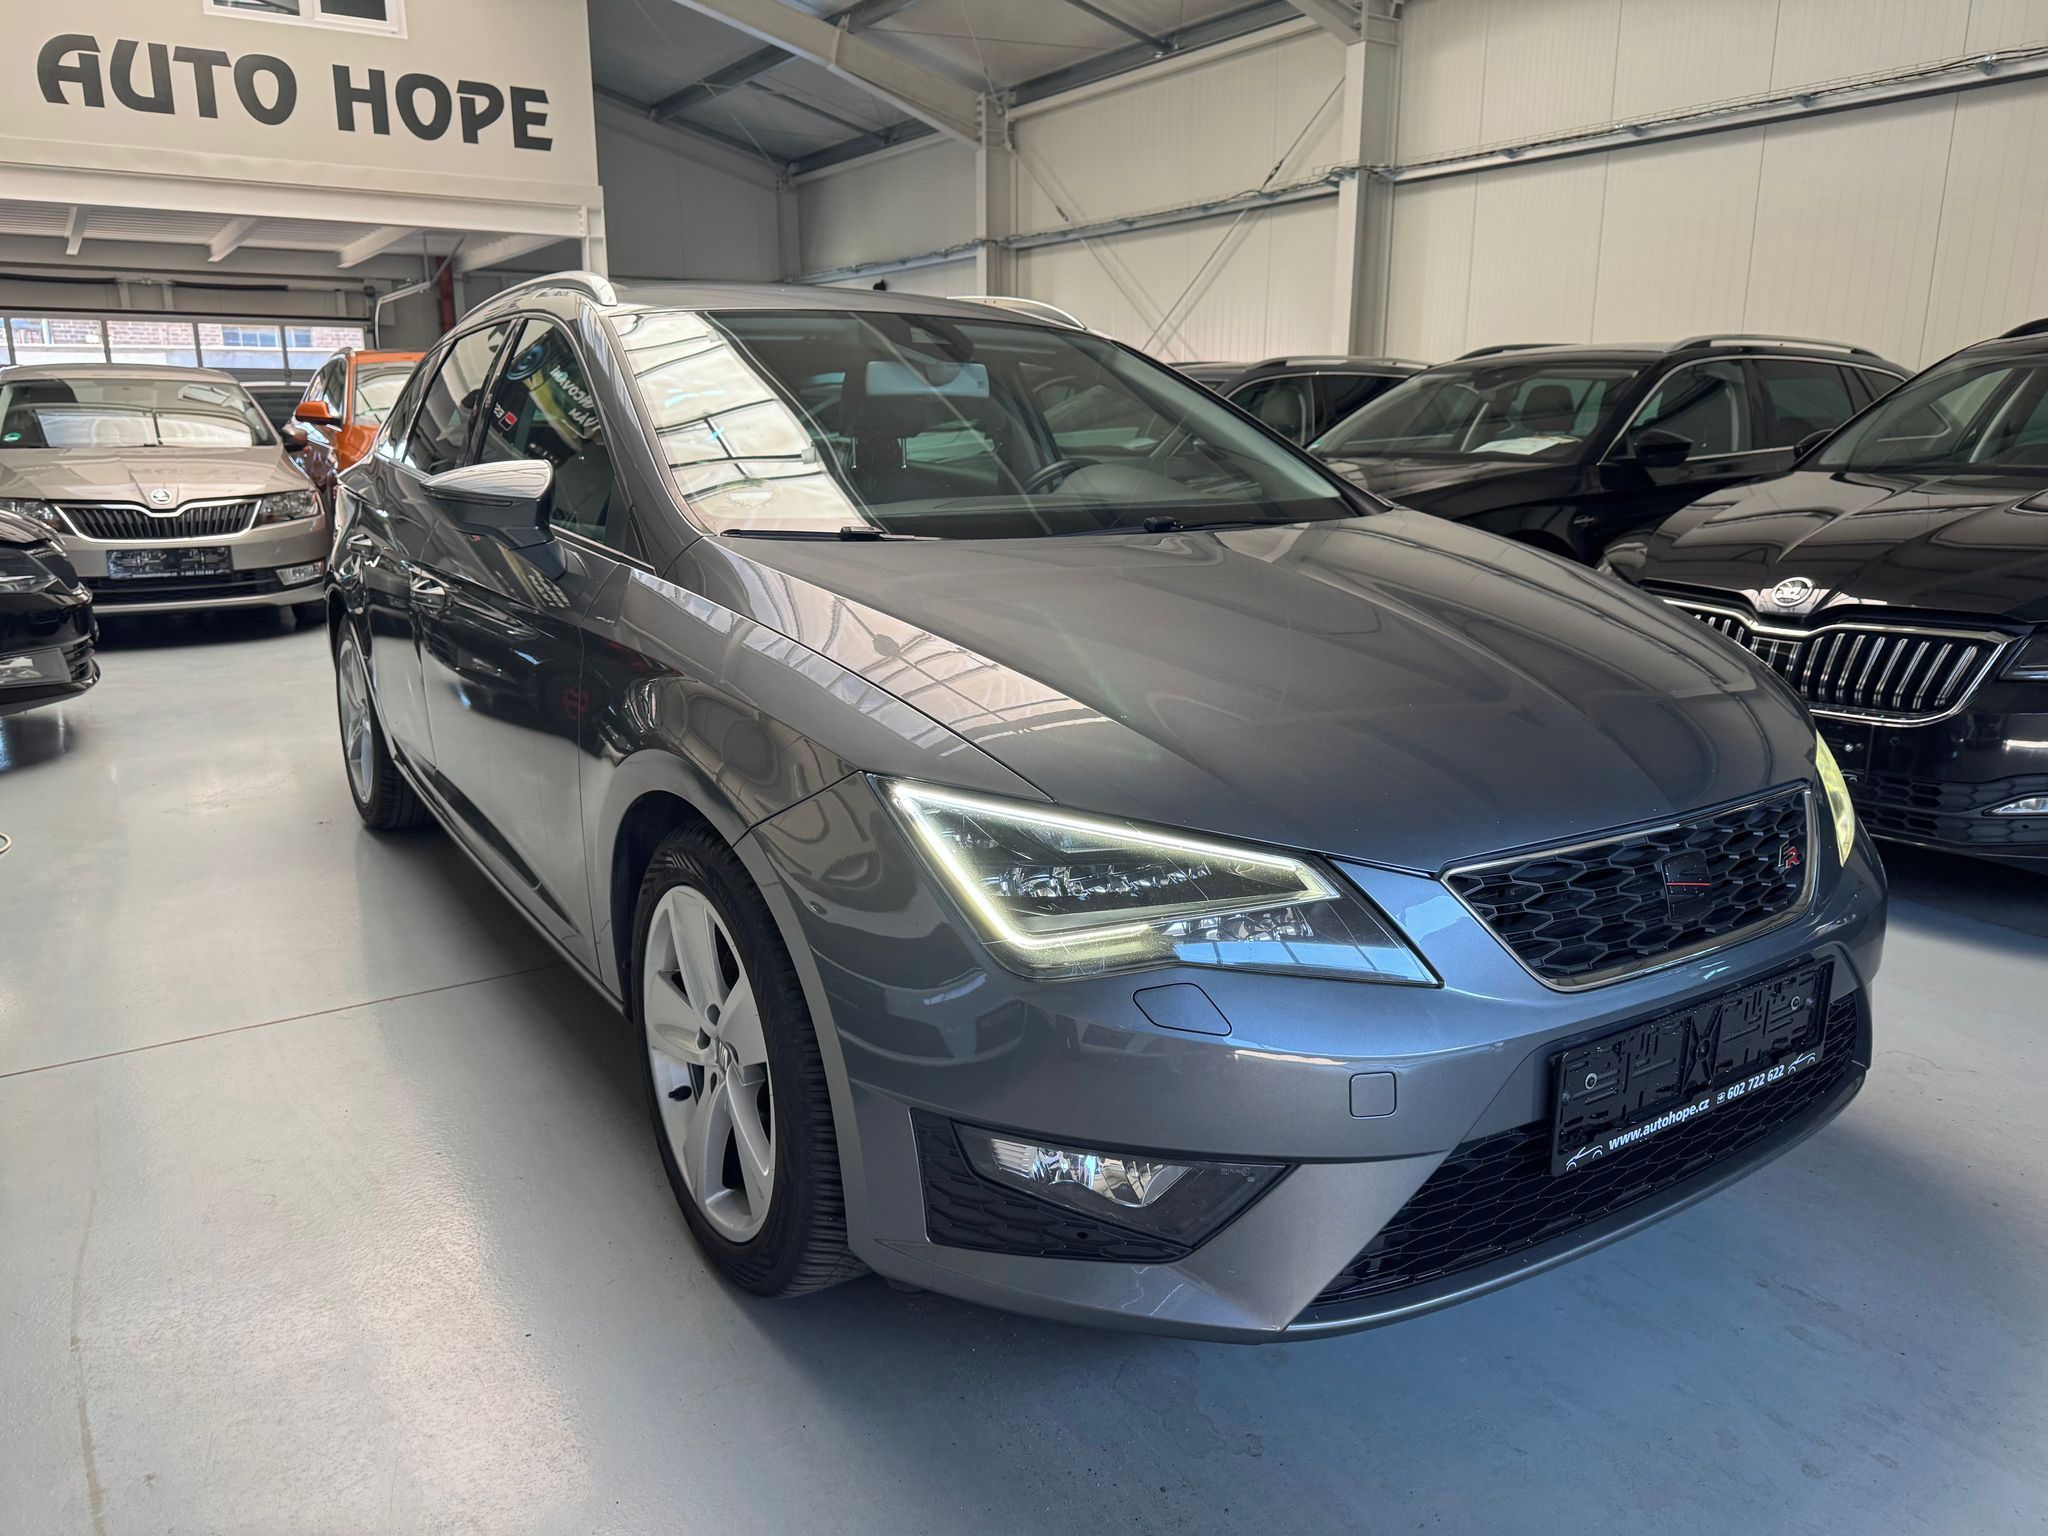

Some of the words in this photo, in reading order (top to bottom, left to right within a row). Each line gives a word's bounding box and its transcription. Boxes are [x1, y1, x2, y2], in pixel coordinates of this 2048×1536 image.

[37, 33, 297, 126] AUTO
[332, 64, 553, 152] HOPE
[1778, 841, 1800, 869] FR
[1609, 1098, 1710, 1150] www.autohope.cz
[1727, 1082, 1745, 1099] 602
[1748, 1073, 1765, 1091] 722
[1767, 1064, 1785, 1082] 622
